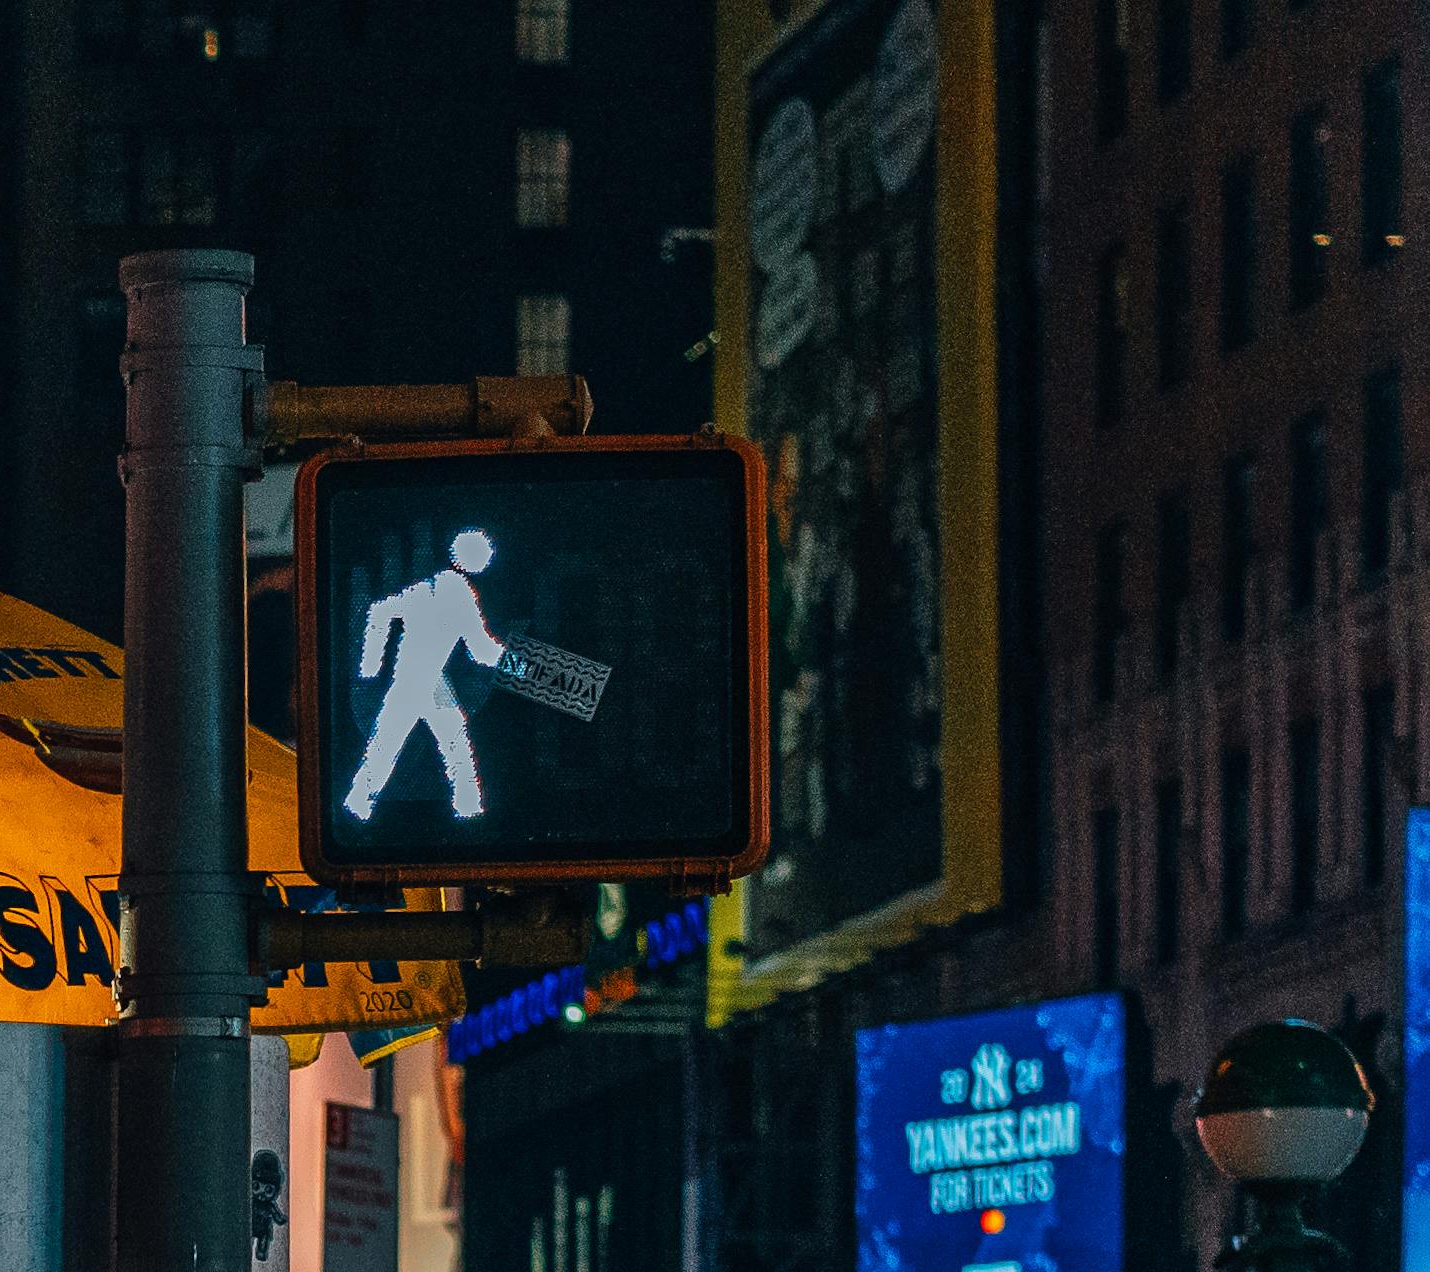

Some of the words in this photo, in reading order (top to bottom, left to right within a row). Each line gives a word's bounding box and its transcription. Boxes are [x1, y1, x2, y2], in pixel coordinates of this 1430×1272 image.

[360, 989, 413, 1013] 2020
[905, 1101, 1081, 1174] YANKEES.COM
[930, 1169, 973, 1214] FOR
[973, 1159, 1056, 1208] TICKETS
